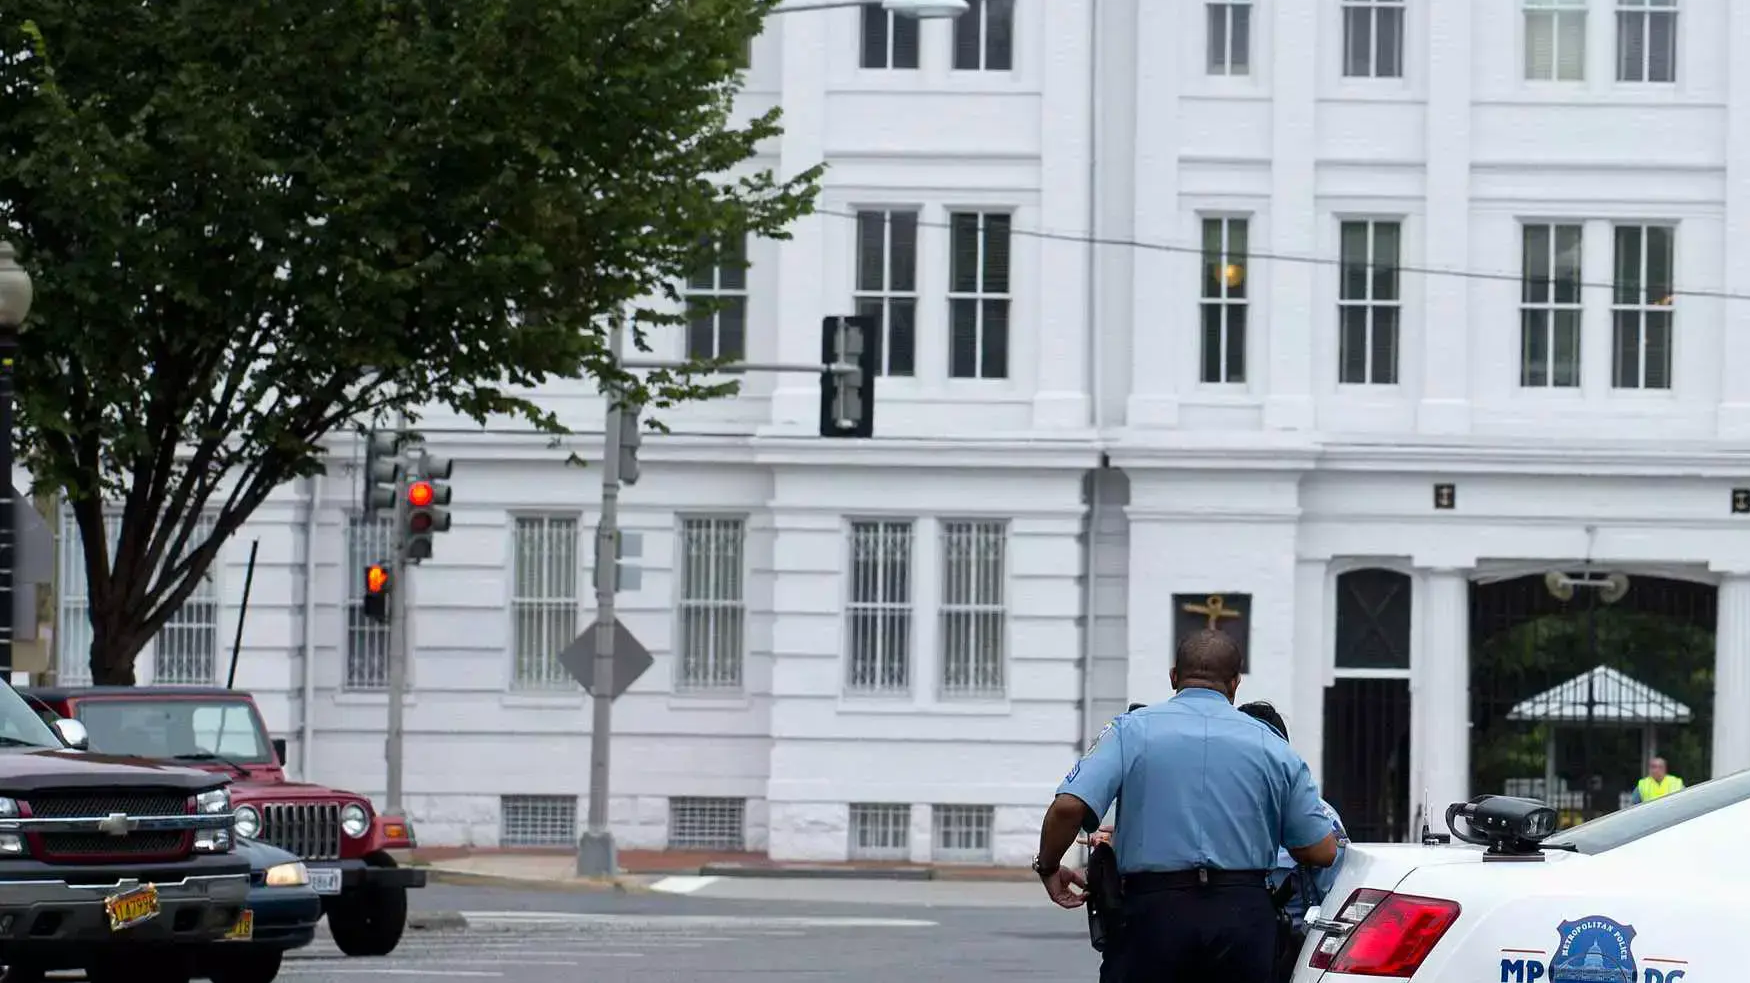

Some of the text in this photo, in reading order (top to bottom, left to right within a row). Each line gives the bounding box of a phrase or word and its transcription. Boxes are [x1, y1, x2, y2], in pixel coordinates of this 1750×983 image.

[1562, 921, 1629, 961] METROPOLITAN POLICE
[1500, 958, 1545, 983] MP
